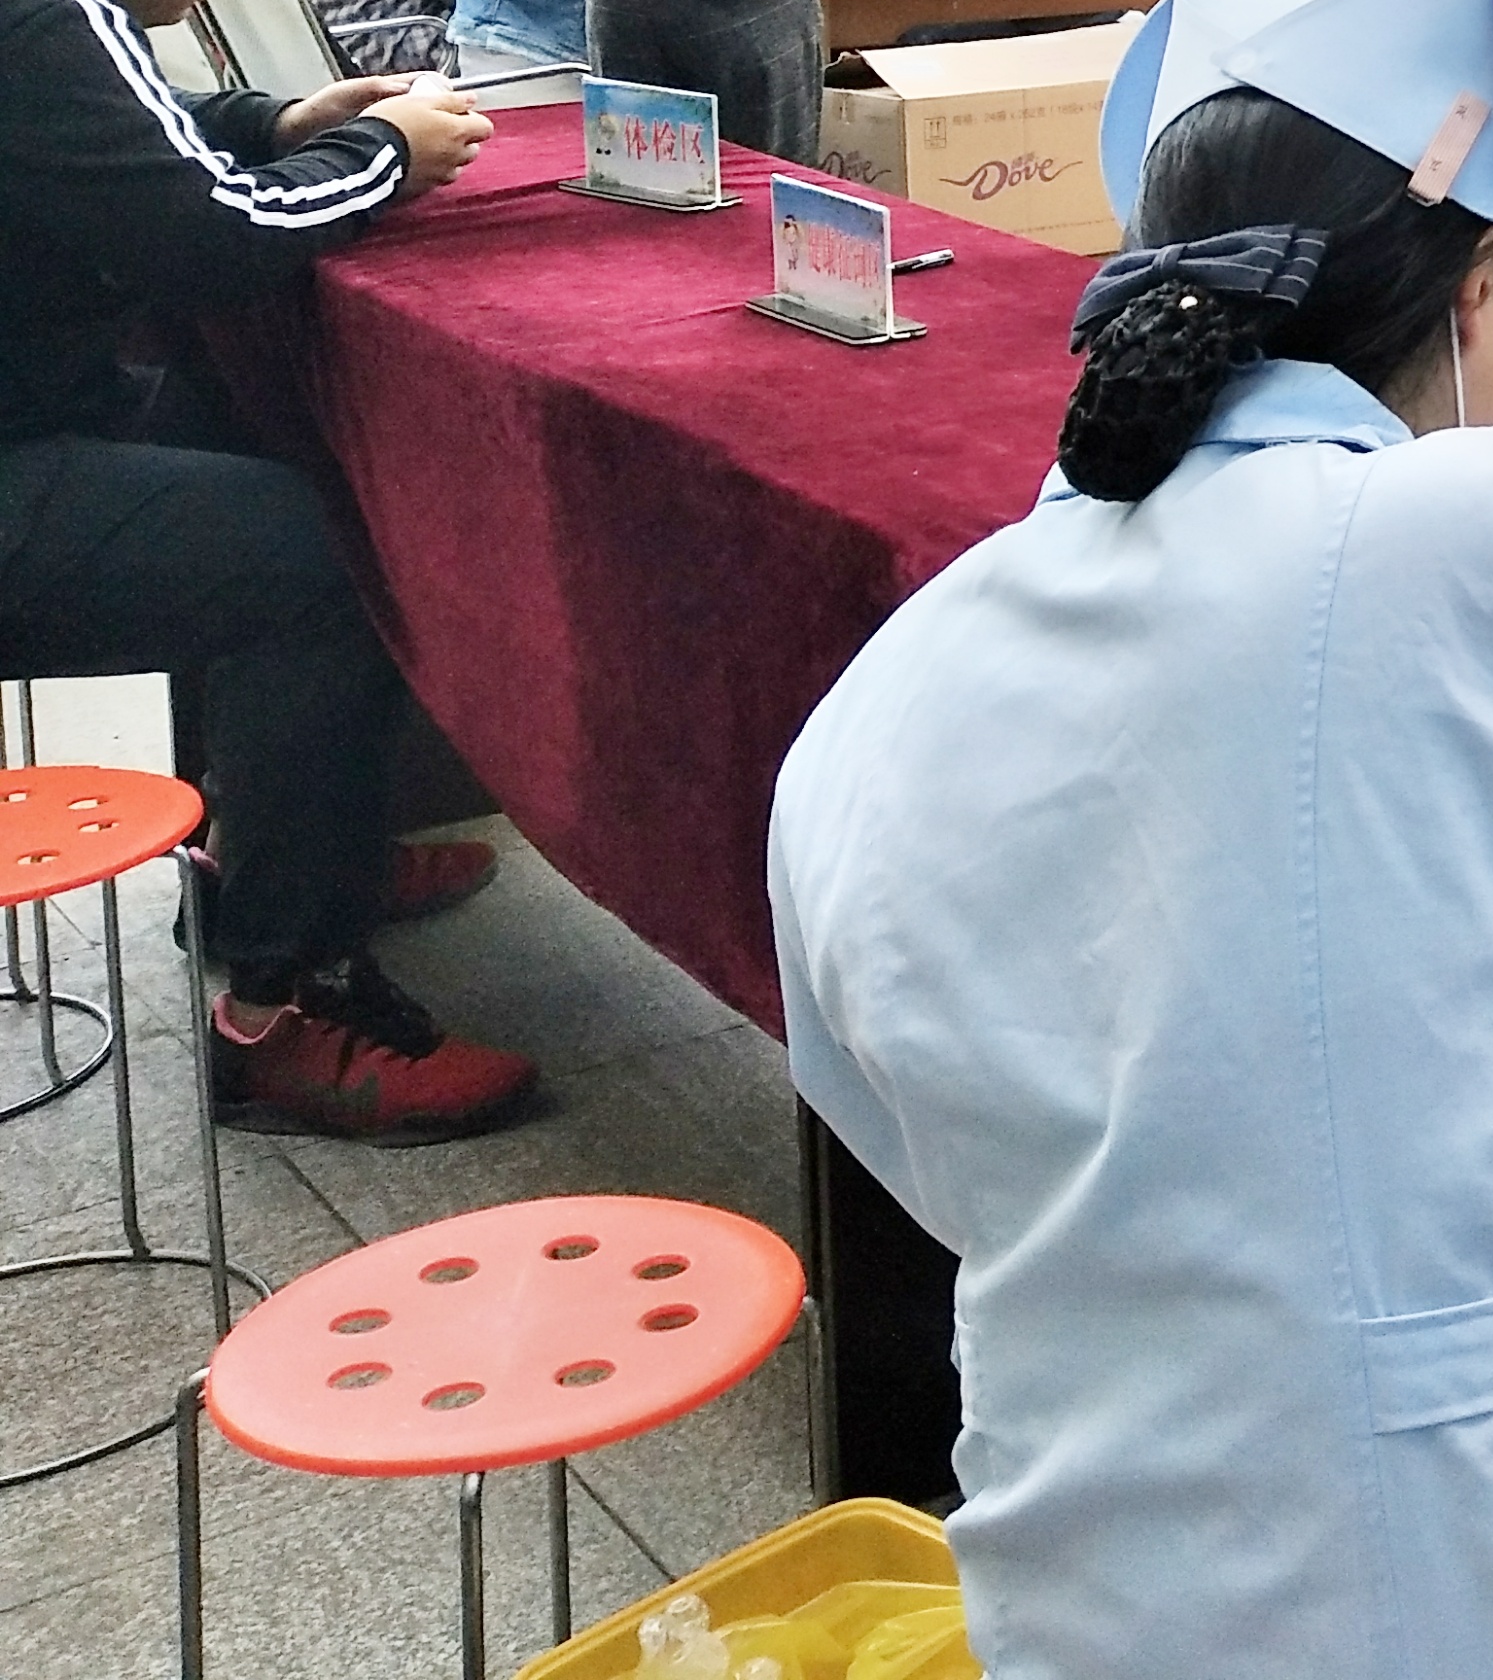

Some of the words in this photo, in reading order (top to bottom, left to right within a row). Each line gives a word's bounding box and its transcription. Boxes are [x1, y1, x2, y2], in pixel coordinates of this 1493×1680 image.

[624, 116, 706, 164] 体检区
[940, 157, 1083, 201] Dove
